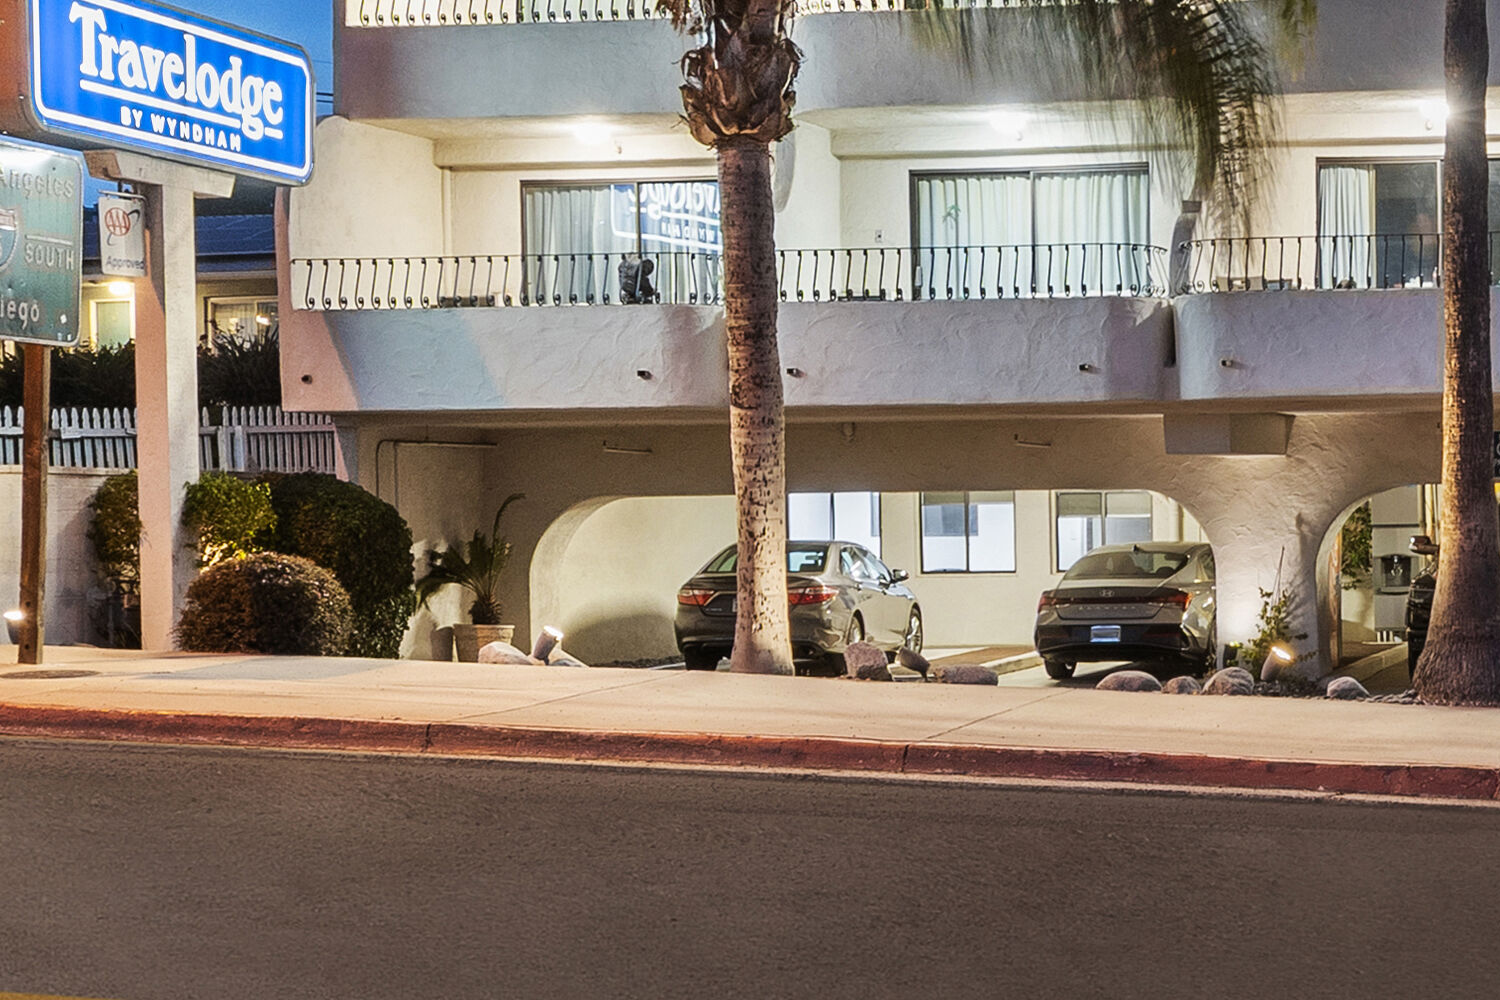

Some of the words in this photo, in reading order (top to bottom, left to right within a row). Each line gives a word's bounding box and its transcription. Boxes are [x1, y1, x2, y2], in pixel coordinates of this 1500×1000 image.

[69, 1, 283, 140] Travelodge
[120, 106, 142, 128] BY
[150, 113, 241, 152] WYNDHAM
[25, 243, 74, 270] SOUTH
[106, 255, 145, 270] Approved
[0, 294, 40, 330] iego
